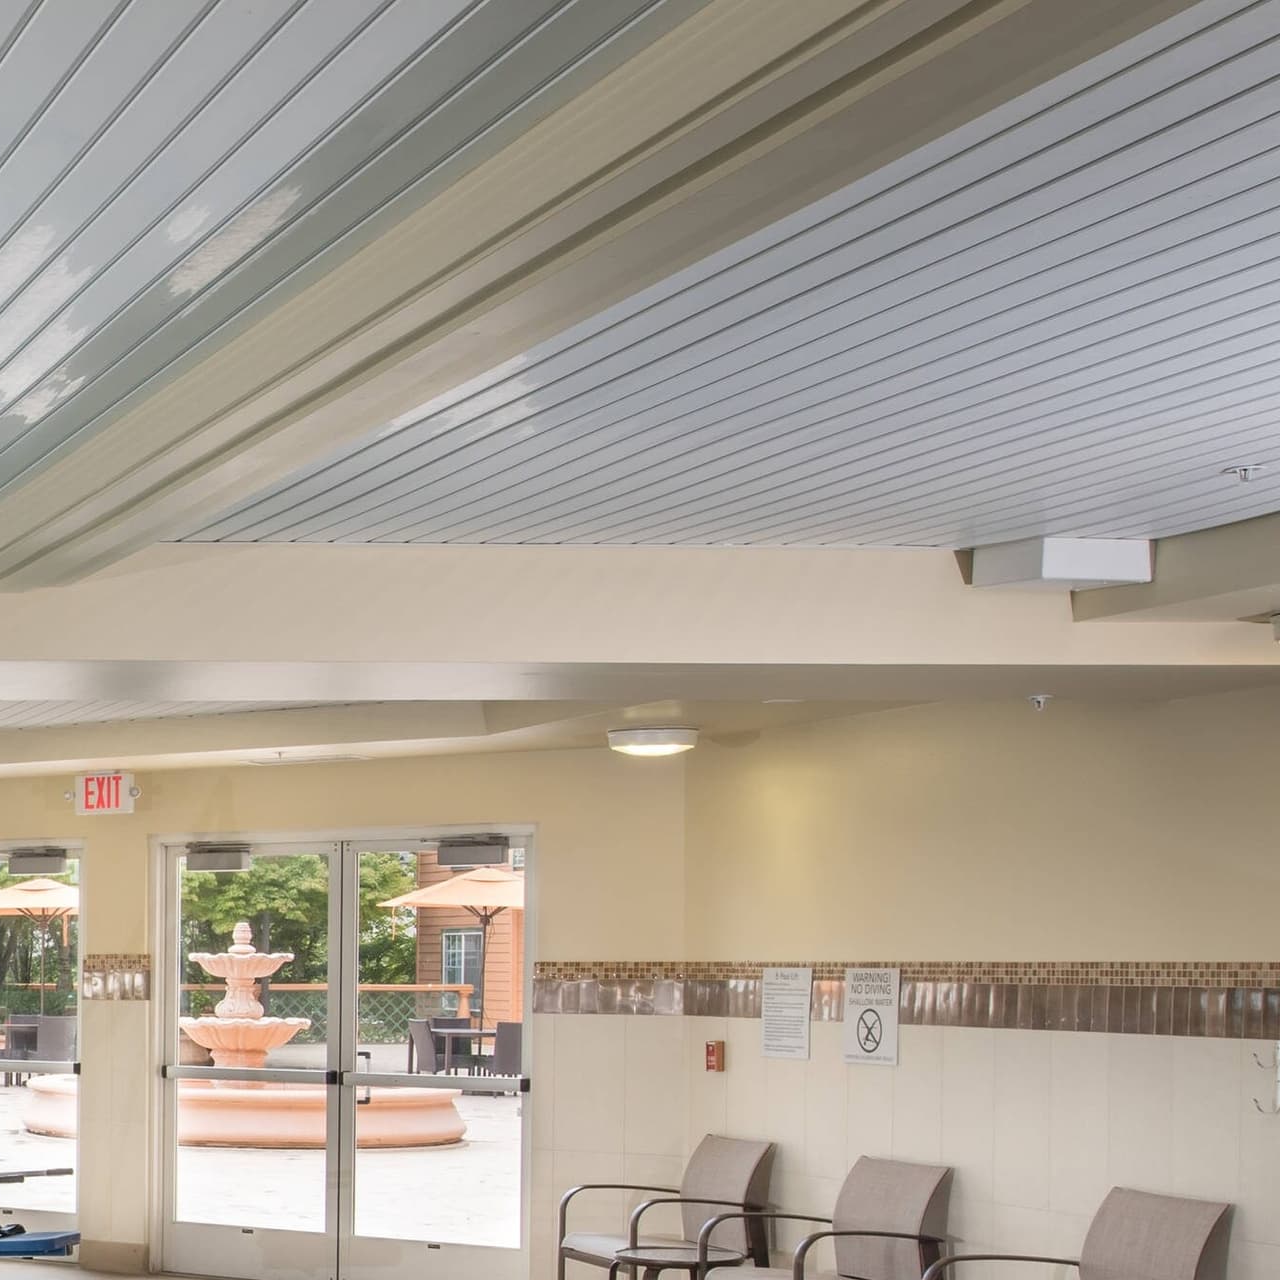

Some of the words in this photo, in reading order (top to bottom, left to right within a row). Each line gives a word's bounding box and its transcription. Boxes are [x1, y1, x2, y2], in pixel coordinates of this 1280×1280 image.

[84, 776, 122, 809] EXIT
[852, 972, 892, 983] WARNING!
[850, 983, 863, 994] NO
[865, 984, 892, 995] DIVING
[848, 998, 873, 1006] SHALLOW
[875, 999, 894, 1007] WATER
